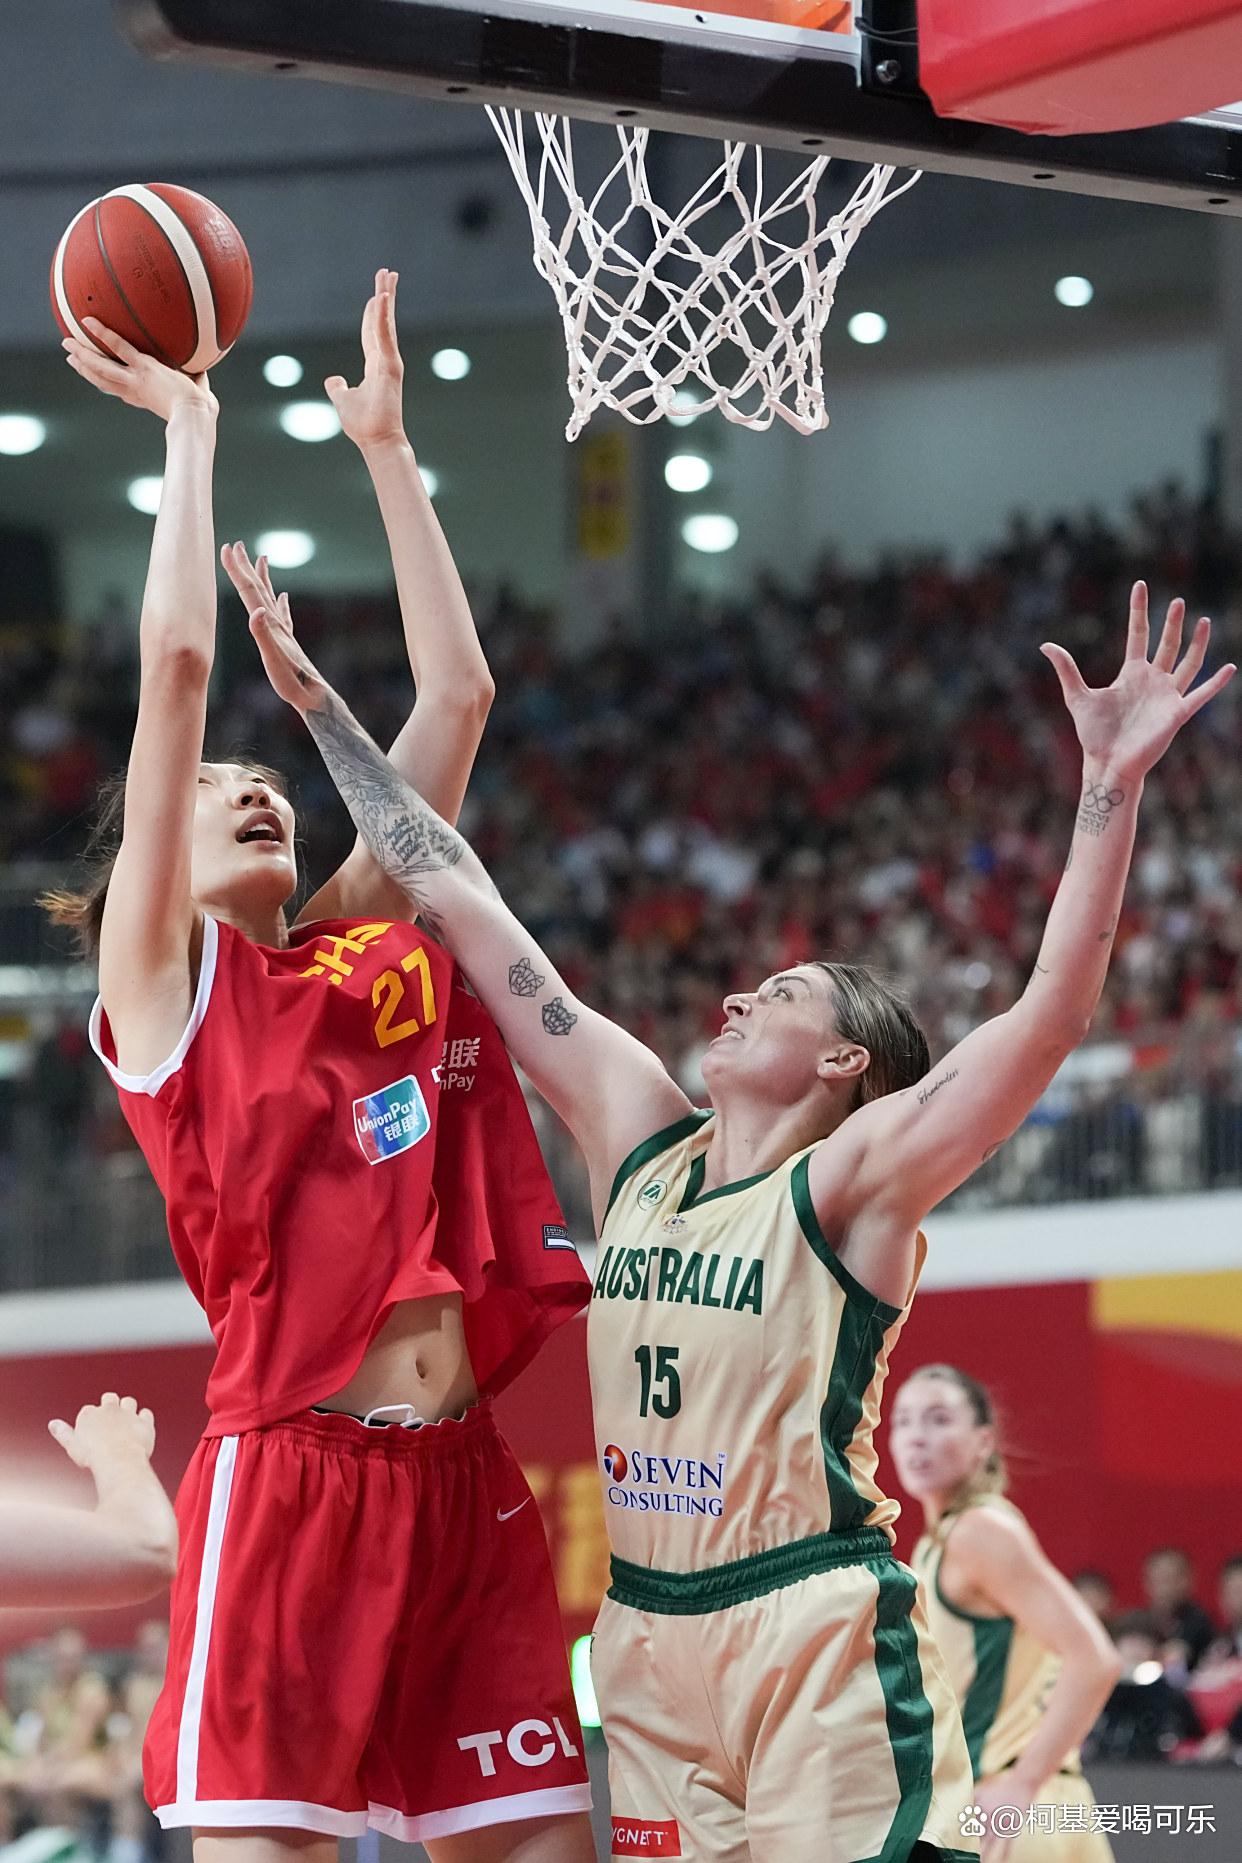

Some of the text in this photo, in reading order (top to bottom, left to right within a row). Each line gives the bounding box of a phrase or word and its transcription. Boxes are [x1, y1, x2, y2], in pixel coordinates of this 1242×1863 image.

[372, 946, 437, 1048] 27
[439, 1072, 476, 1091] nPay
[357, 1099, 418, 1133] UnionPay
[384, 1114, 420, 1142] 银联
[593, 1245, 764, 1316] AUSTRALIA
[634, 1344, 682, 1419] 15
[456, 1716, 579, 1777] TCL
